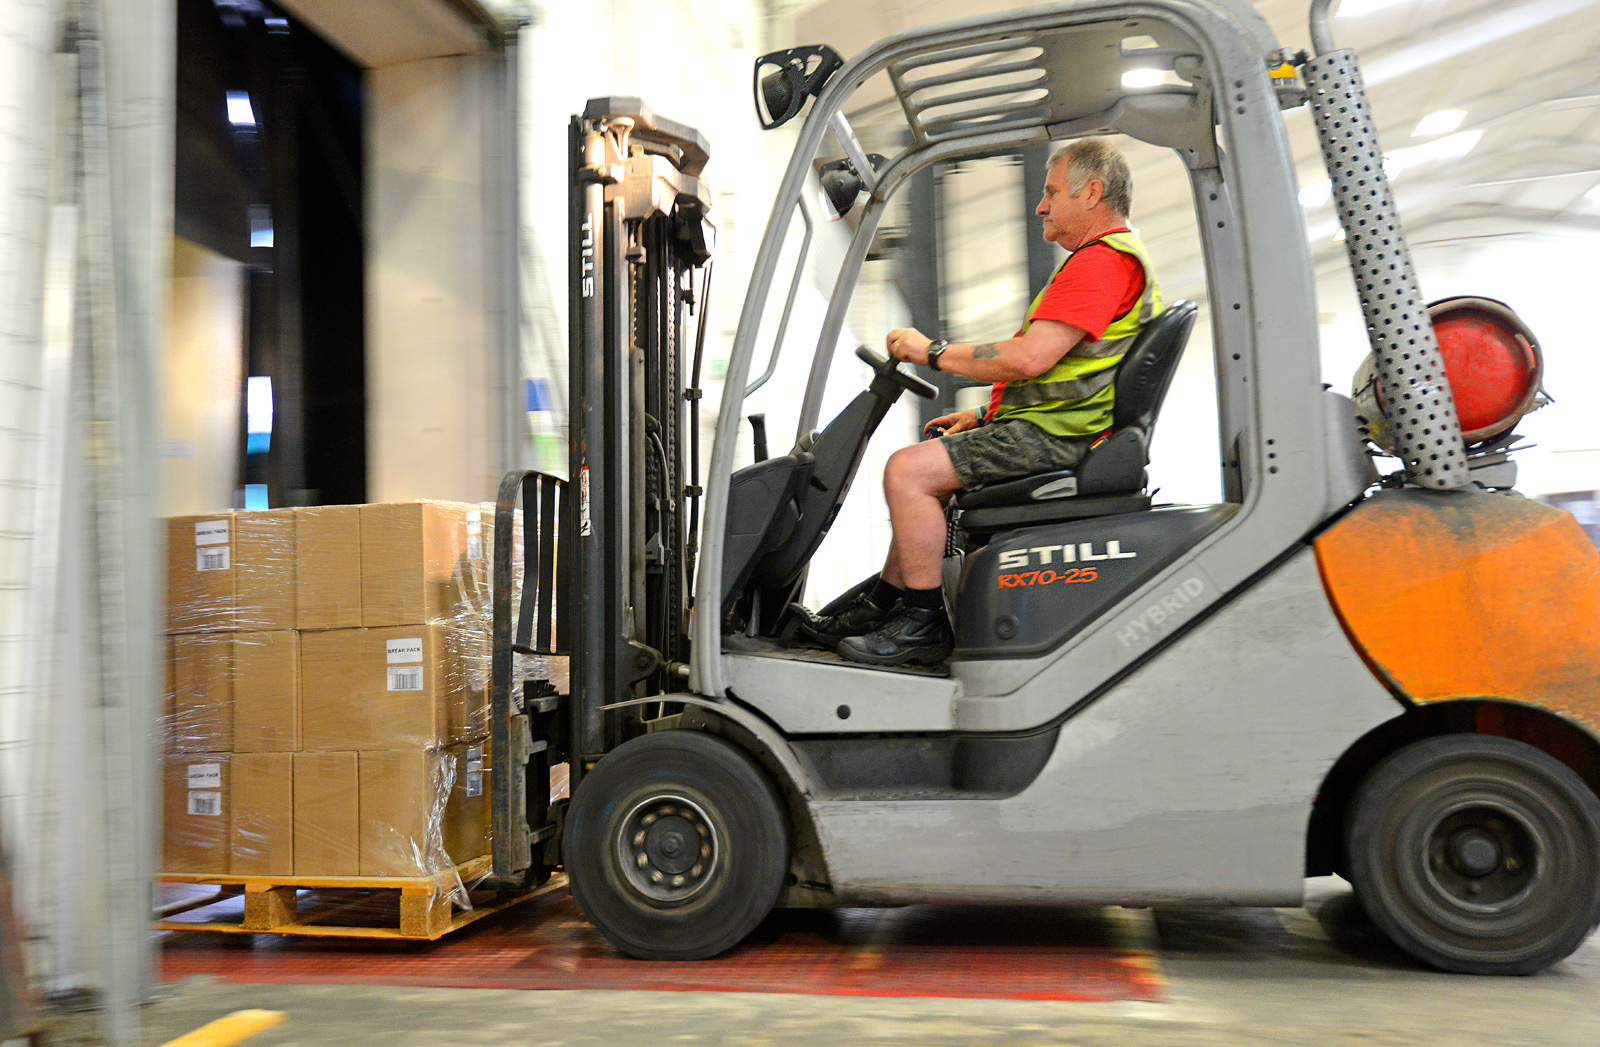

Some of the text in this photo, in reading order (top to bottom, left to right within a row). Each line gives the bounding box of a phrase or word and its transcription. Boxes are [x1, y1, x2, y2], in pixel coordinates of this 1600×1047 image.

[581, 212, 594, 298] STILL
[997, 566, 1099, 589] RX70-25
[998, 540, 1137, 570] STILL
[1114, 576, 1206, 648] HYBRID
